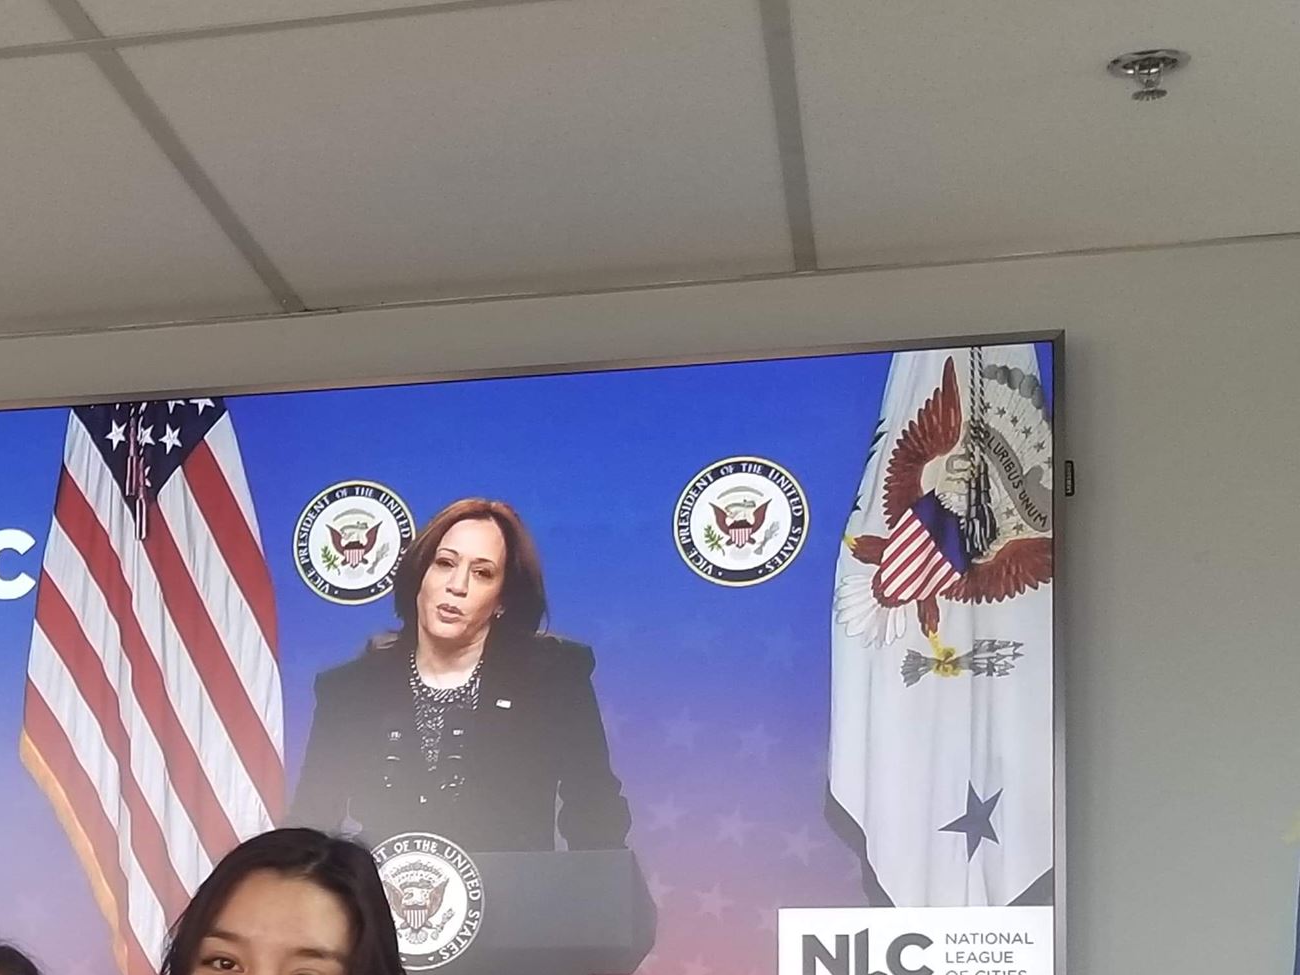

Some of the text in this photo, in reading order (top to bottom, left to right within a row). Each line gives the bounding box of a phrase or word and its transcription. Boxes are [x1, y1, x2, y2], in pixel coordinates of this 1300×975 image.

[335, 488, 348, 499] OF
[355, 487, 374, 498] THE
[380, 493, 411, 539] UNITED
[679, 463, 803, 575] VICE PRESIDENT OF THE UNITED STATES
[1019, 490, 1047, 528] UNUM
[298, 496, 330, 565] PRESIDENT
[307, 568, 330, 594] VICE
[394, 839, 481, 960] OF THE UNITED STATES
[945, 932, 1034, 945] NATIONAL
[945, 951, 1014, 964] LEAGUE
